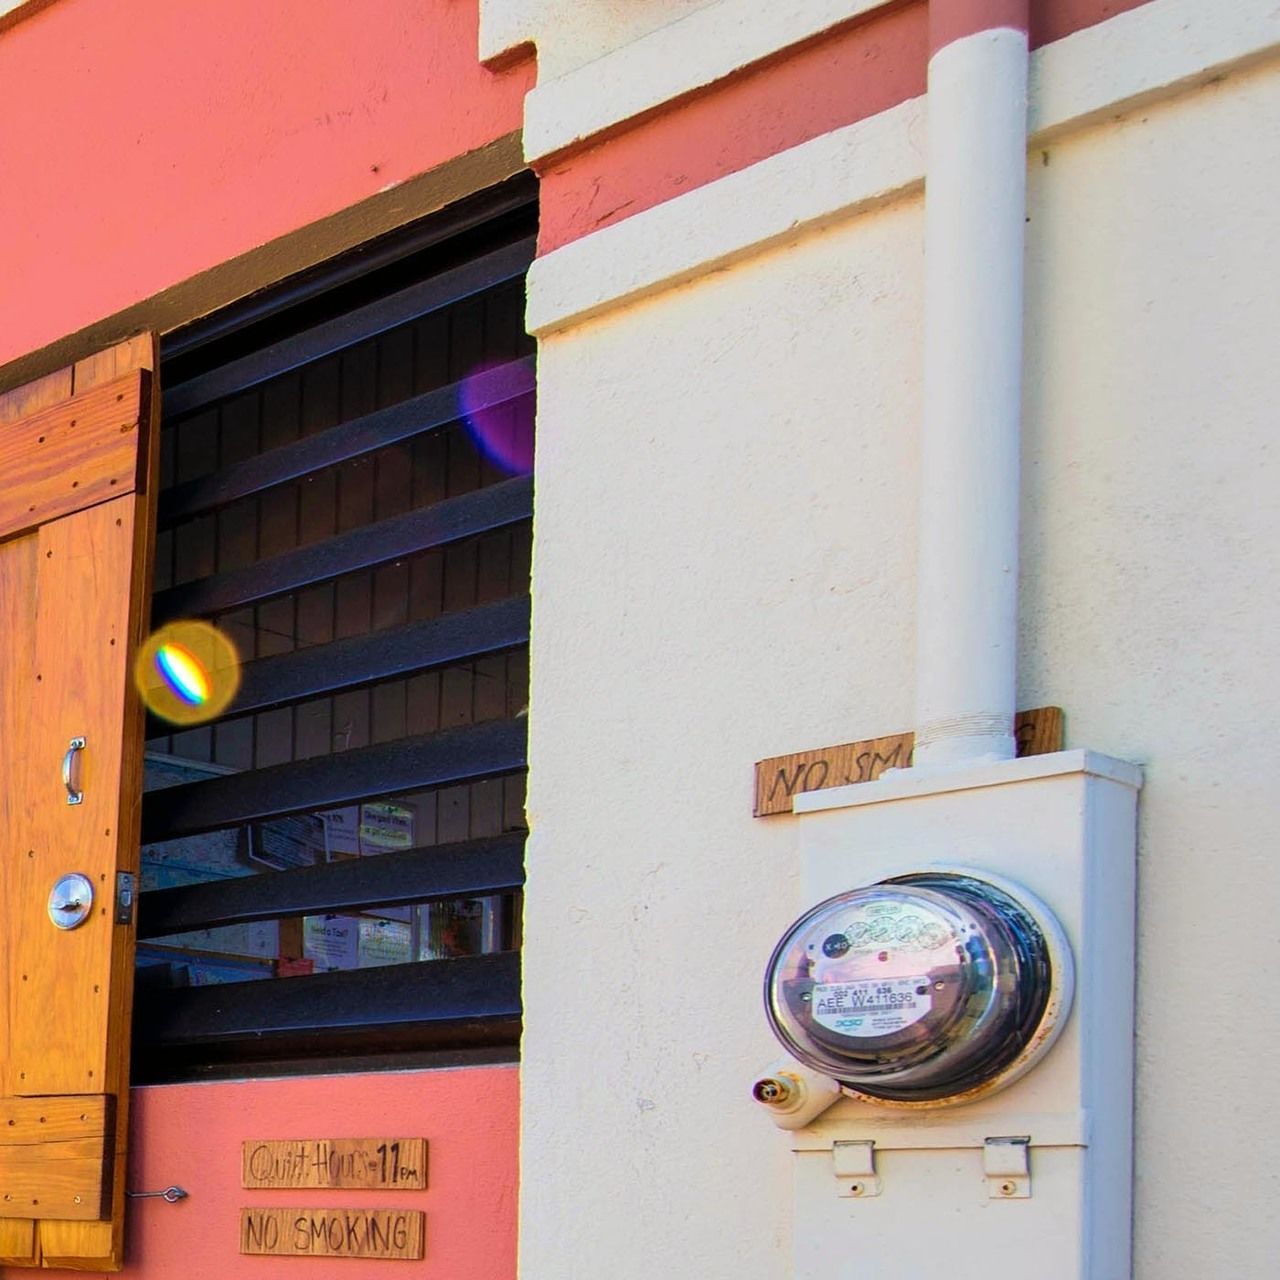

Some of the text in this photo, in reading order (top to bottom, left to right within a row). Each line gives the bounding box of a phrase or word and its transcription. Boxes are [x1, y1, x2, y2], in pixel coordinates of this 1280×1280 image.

[768, 761, 828, 802] NO
[246, 1214, 407, 1253] NO SMOKING
